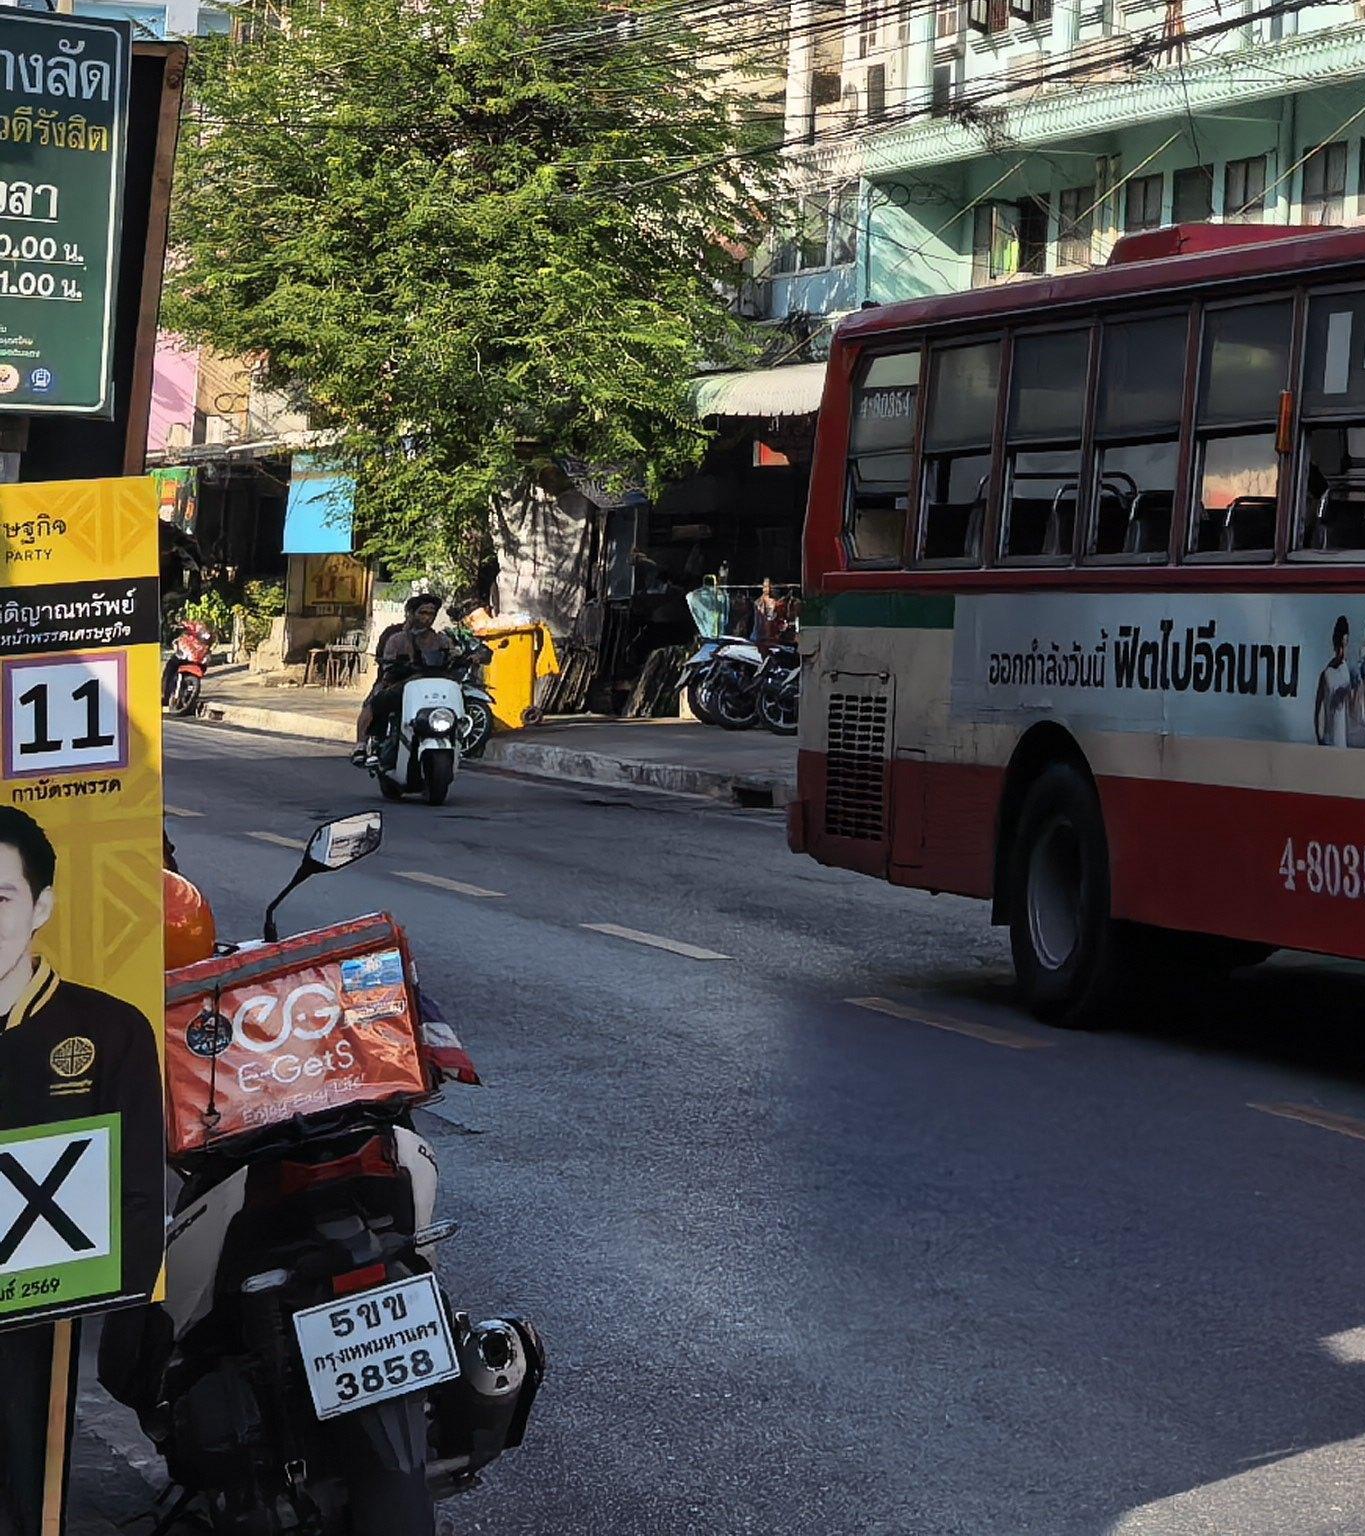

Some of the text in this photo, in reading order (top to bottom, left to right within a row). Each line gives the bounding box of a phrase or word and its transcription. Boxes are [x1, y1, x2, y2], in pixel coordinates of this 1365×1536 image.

[5, 548, 53, 564] PARTY
[18, 678, 116, 756] 11
[21, 1276, 61, 1300] 2569
[328, 1292, 408, 1338] 5ขข
[313, 1320, 439, 1374] กรุงเทพมหานคร
[335, 1348, 435, 1402] 3858
